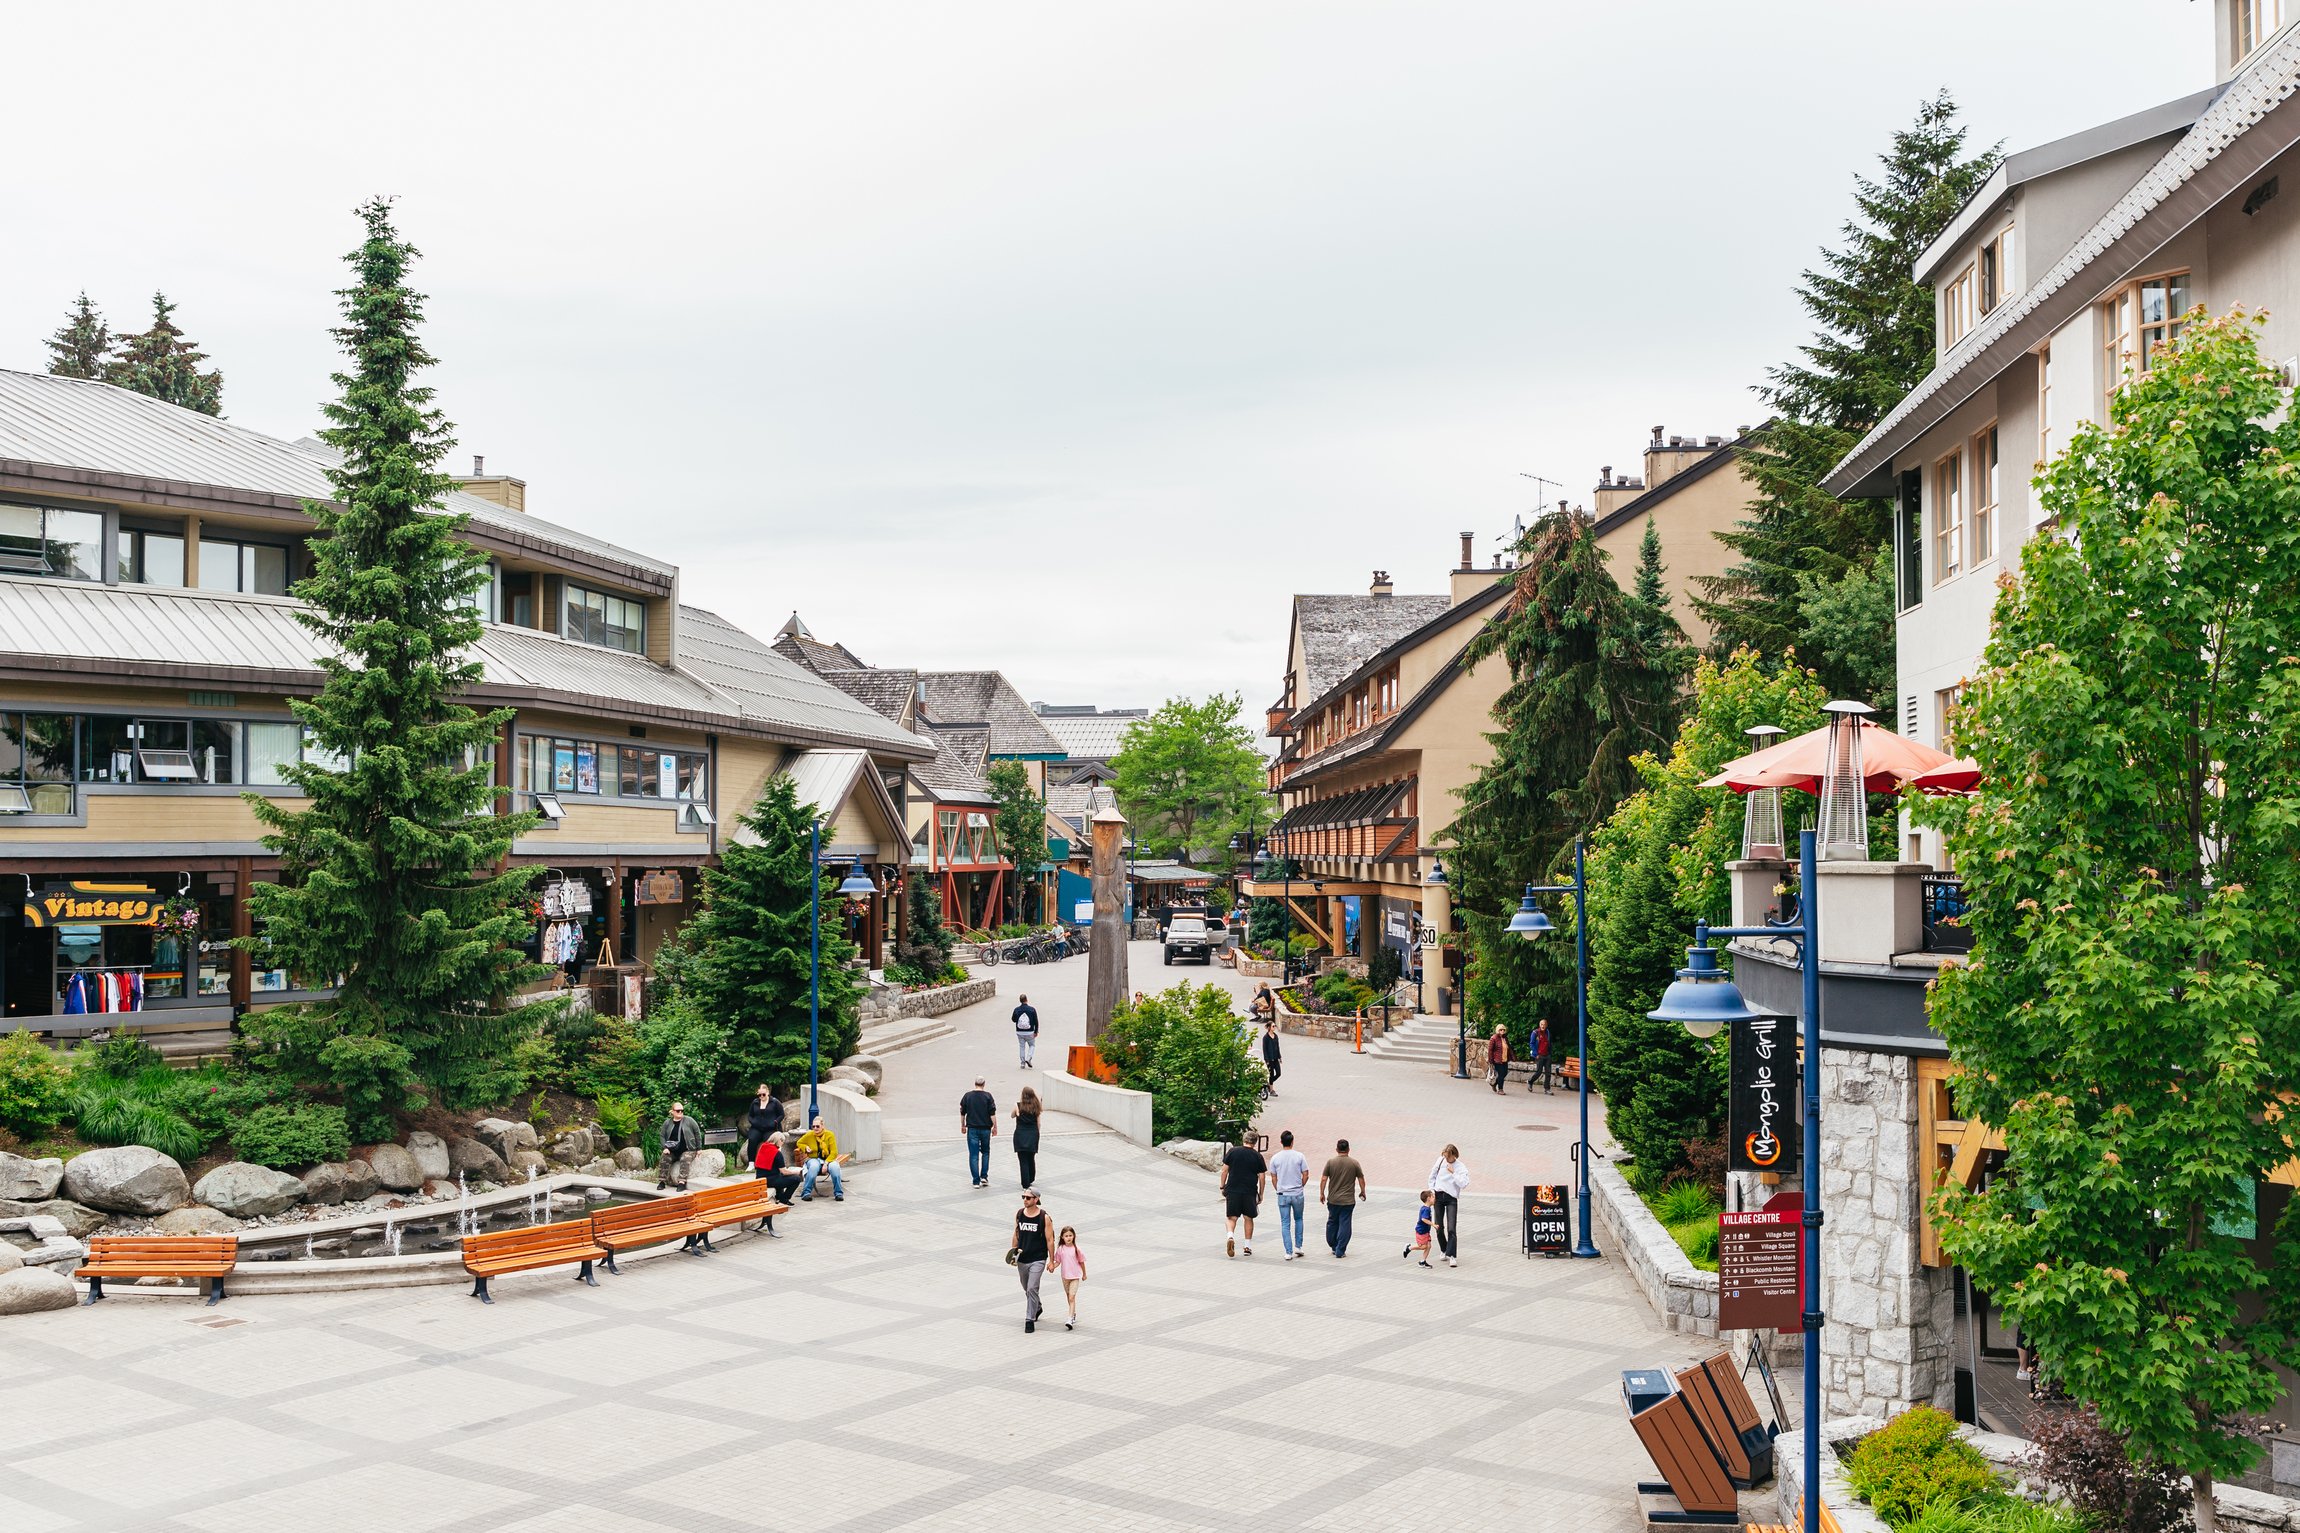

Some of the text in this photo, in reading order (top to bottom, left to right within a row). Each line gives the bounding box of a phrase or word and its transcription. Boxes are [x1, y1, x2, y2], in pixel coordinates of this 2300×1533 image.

[44, 898, 148, 920] Vintage
[1421, 929, 1435, 944] SO
[1750, 1020, 1779, 1155] Mongolie Grill
[1723, 1213, 1780, 1225] VILLAGE CENTRE
[1019, 1222, 1038, 1232] VANS
[1532, 1222, 1565, 1232] OPEN
[1765, 1231, 1782, 1239] Village
